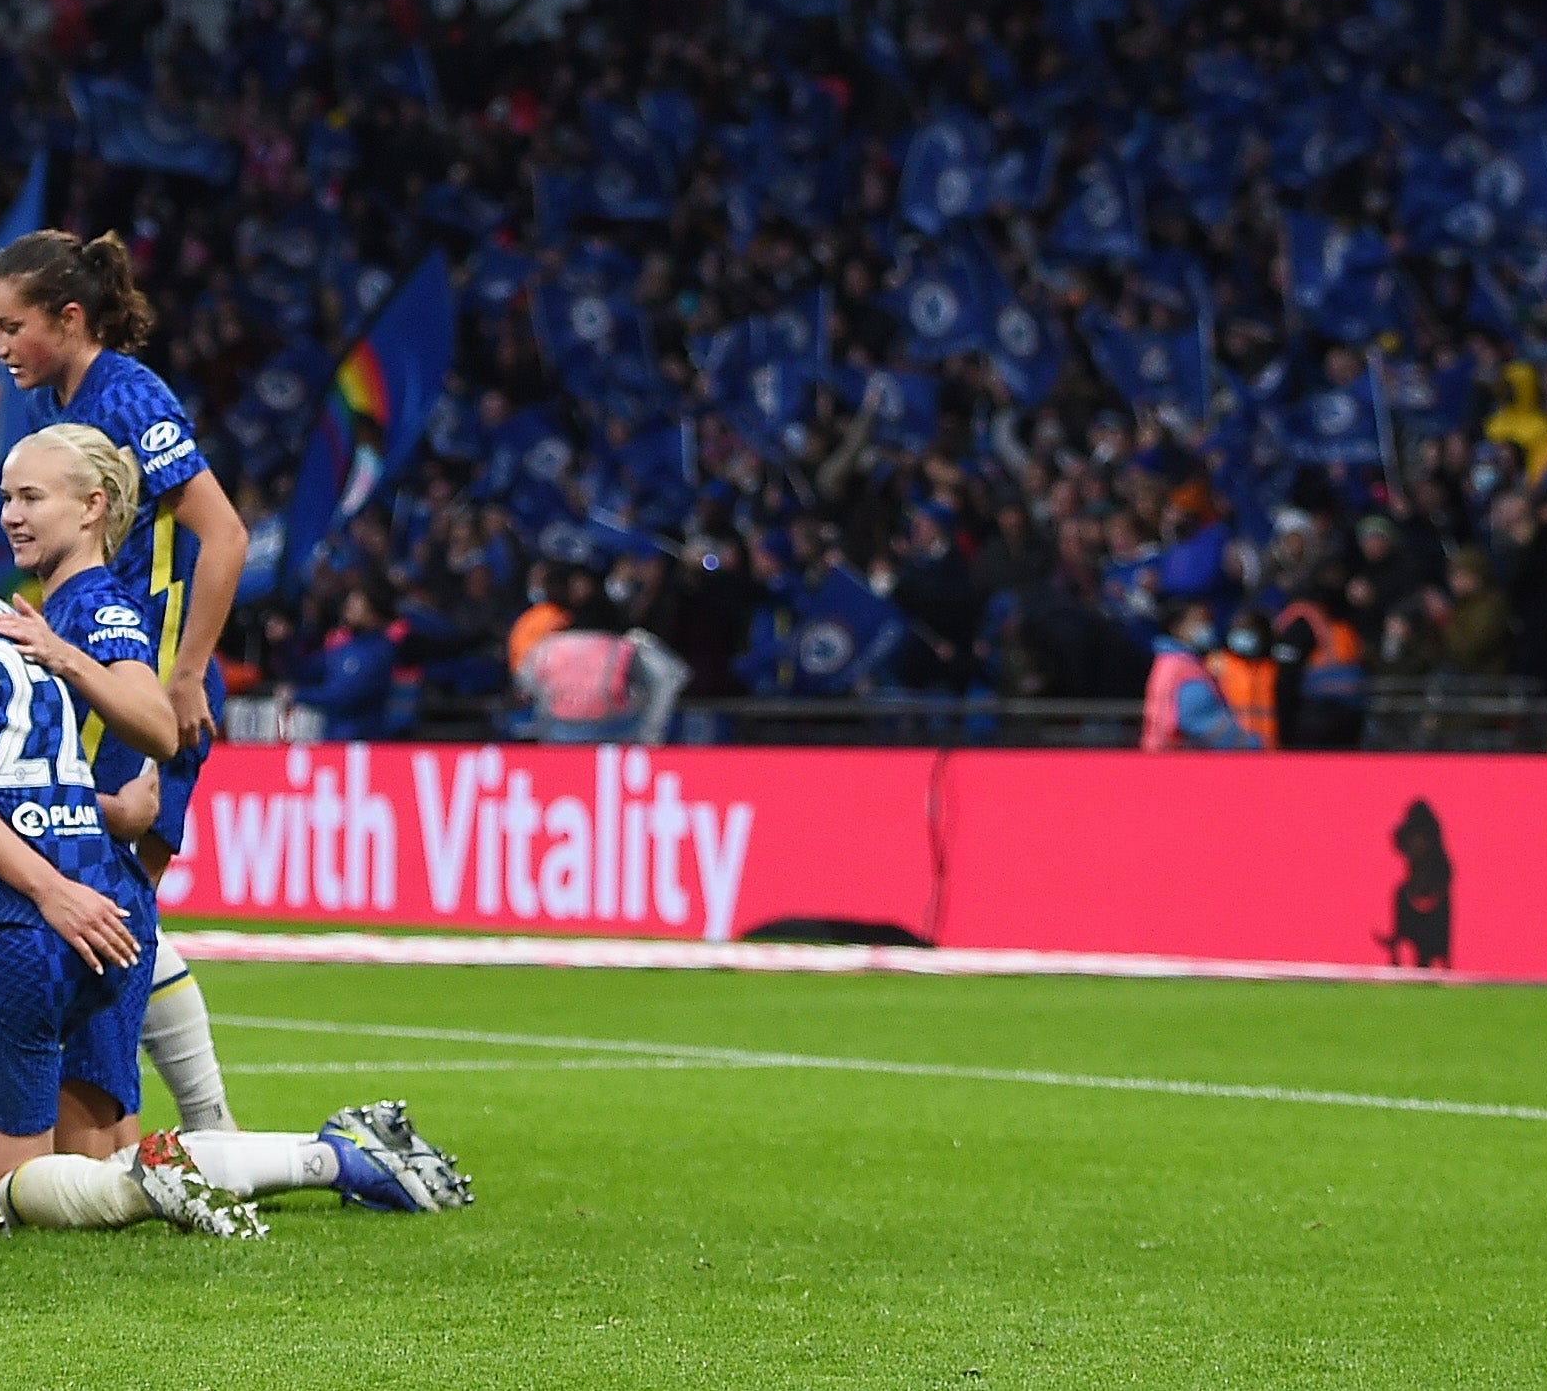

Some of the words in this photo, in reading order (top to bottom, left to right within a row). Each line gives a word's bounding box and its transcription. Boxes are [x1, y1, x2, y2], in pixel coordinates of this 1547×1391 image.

[50, 805, 98, 826] PLAN
[211, 741, 398, 910] with
[410, 743, 756, 940] Vitality
